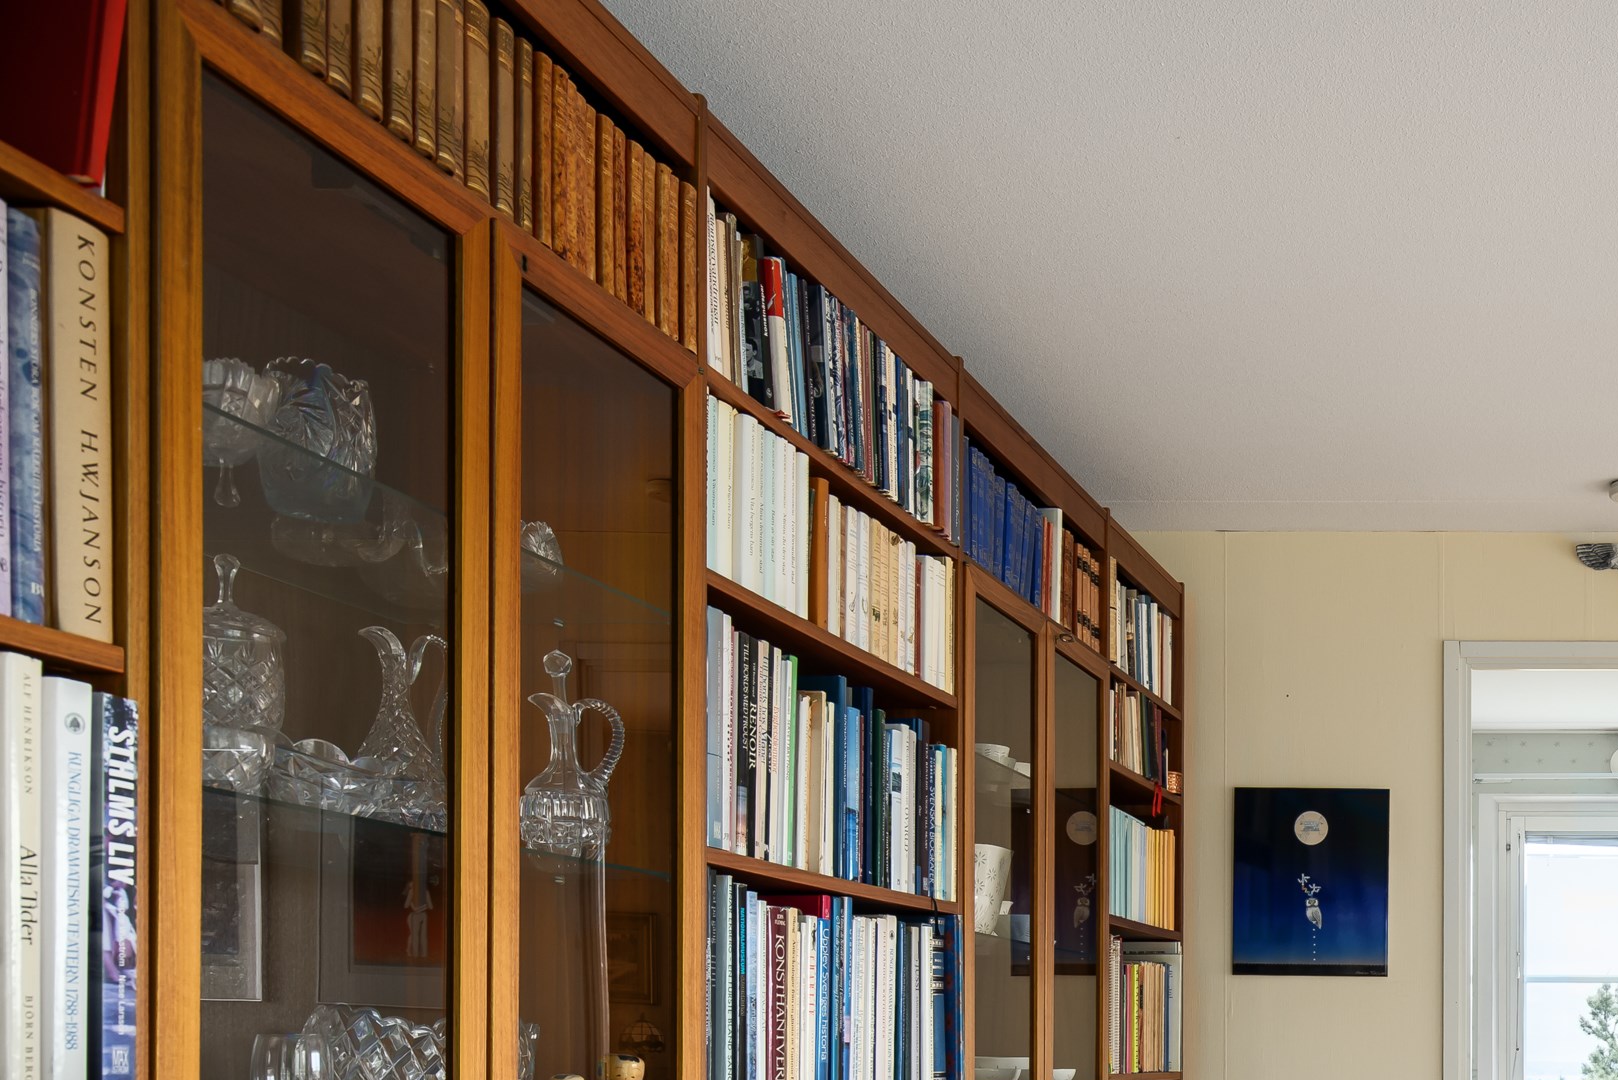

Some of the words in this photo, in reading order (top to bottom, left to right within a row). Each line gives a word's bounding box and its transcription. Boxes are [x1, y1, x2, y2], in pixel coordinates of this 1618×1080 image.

[78, 235, 97, 402] KONSTEN
[23, 706, 33, 796] HENRIKSON
[748, 702, 757, 769] RENOIR
[67, 752, 82, 822] KUNGLIGA
[109, 726, 135, 838] STHLMS
[20, 846, 38, 886] Alla
[67, 827, 81, 916] DRAMATISKA
[108, 842, 134, 886] LIV
[20, 892, 38, 945] Tider
[65, 921, 80, 984] TEATERN
[821, 928, 830, 968] Upplev
[118, 975, 126, 998] Nisse
[820, 972, 829, 1016] Sveriges
[25, 996, 34, 1039] BJÖRN
[821, 1019, 829, 1060] historia
